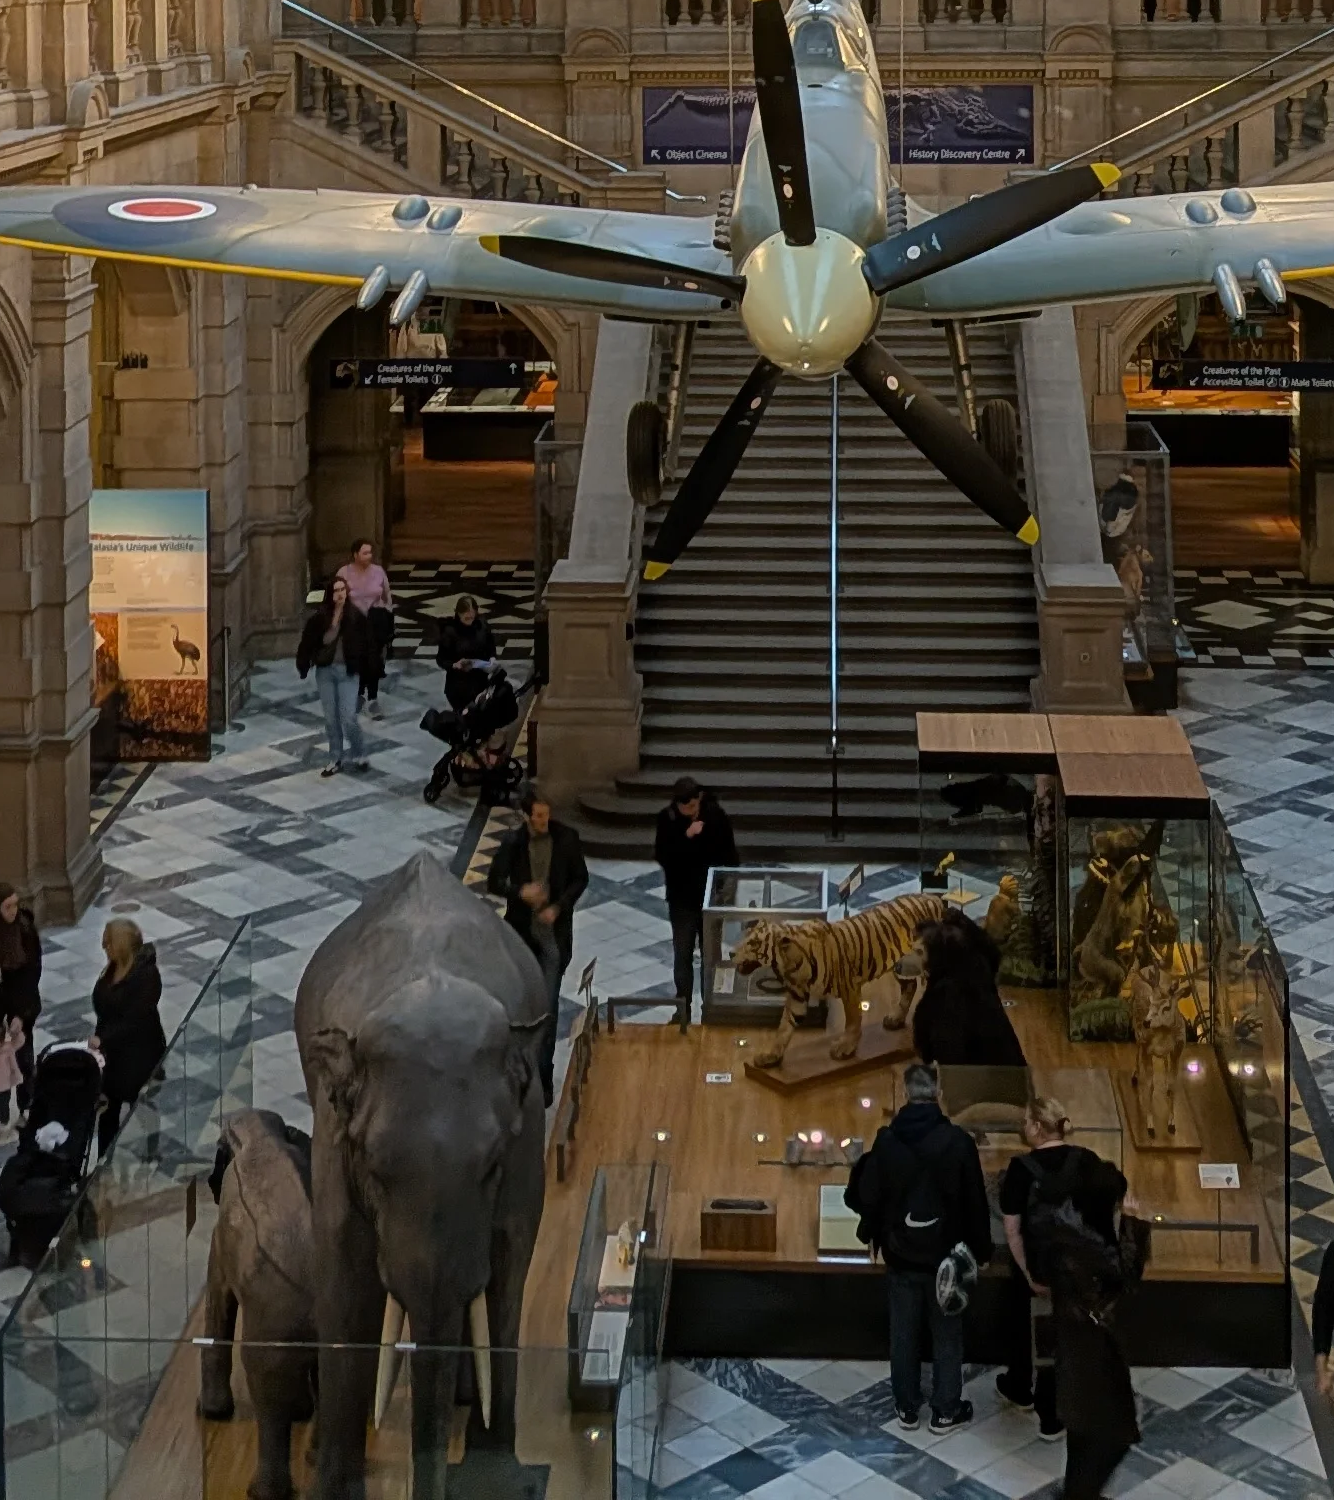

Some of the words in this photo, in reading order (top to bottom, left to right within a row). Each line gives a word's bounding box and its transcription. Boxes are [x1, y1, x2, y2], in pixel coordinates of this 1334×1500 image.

[666, 150, 693, 160] Object
[696, 150, 727, 159] Cinema
[909, 149, 939, 160] History
[941, 149, 981, 160] Discovery
[982, 149, 1010, 159] Centre
[377, 364, 412, 373] Creatures
[414, 364, 422, 373] of
[423, 364, 435, 373] the
[436, 364, 452, 373] Past
[1203, 366, 1239, 375] Creatures
[1241, 366, 1249, 375] of
[1251, 366, 1263, 375] the
[1265, 366, 1281, 375] Past
[1203, 377, 1242, 386] Accessible
[1244, 377, 1265, 386] Toilet
[126, 543, 157, 553] Unique
[160, 543, 194, 552] Wildlife
